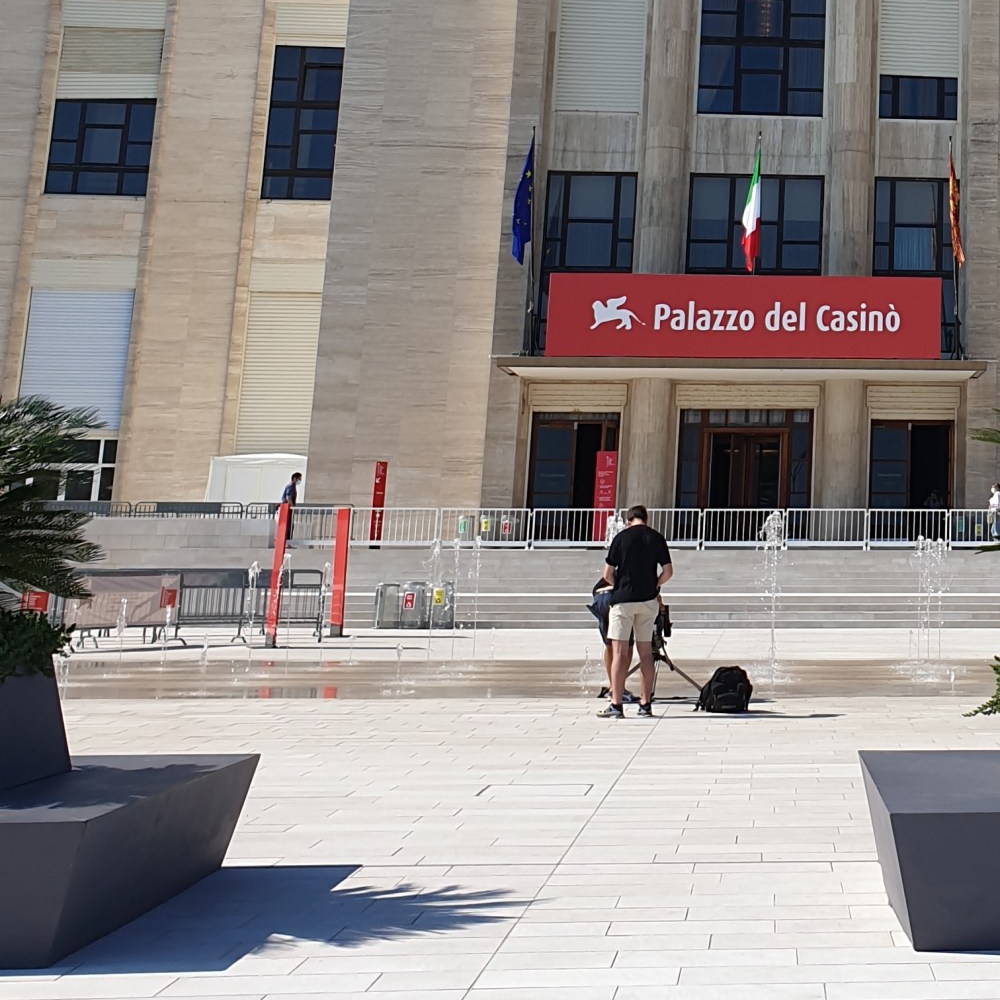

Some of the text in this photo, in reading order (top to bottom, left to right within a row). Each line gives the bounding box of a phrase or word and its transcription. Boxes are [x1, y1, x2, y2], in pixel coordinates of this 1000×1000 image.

[654, 300, 901, 332] Palazzo del Casinò
